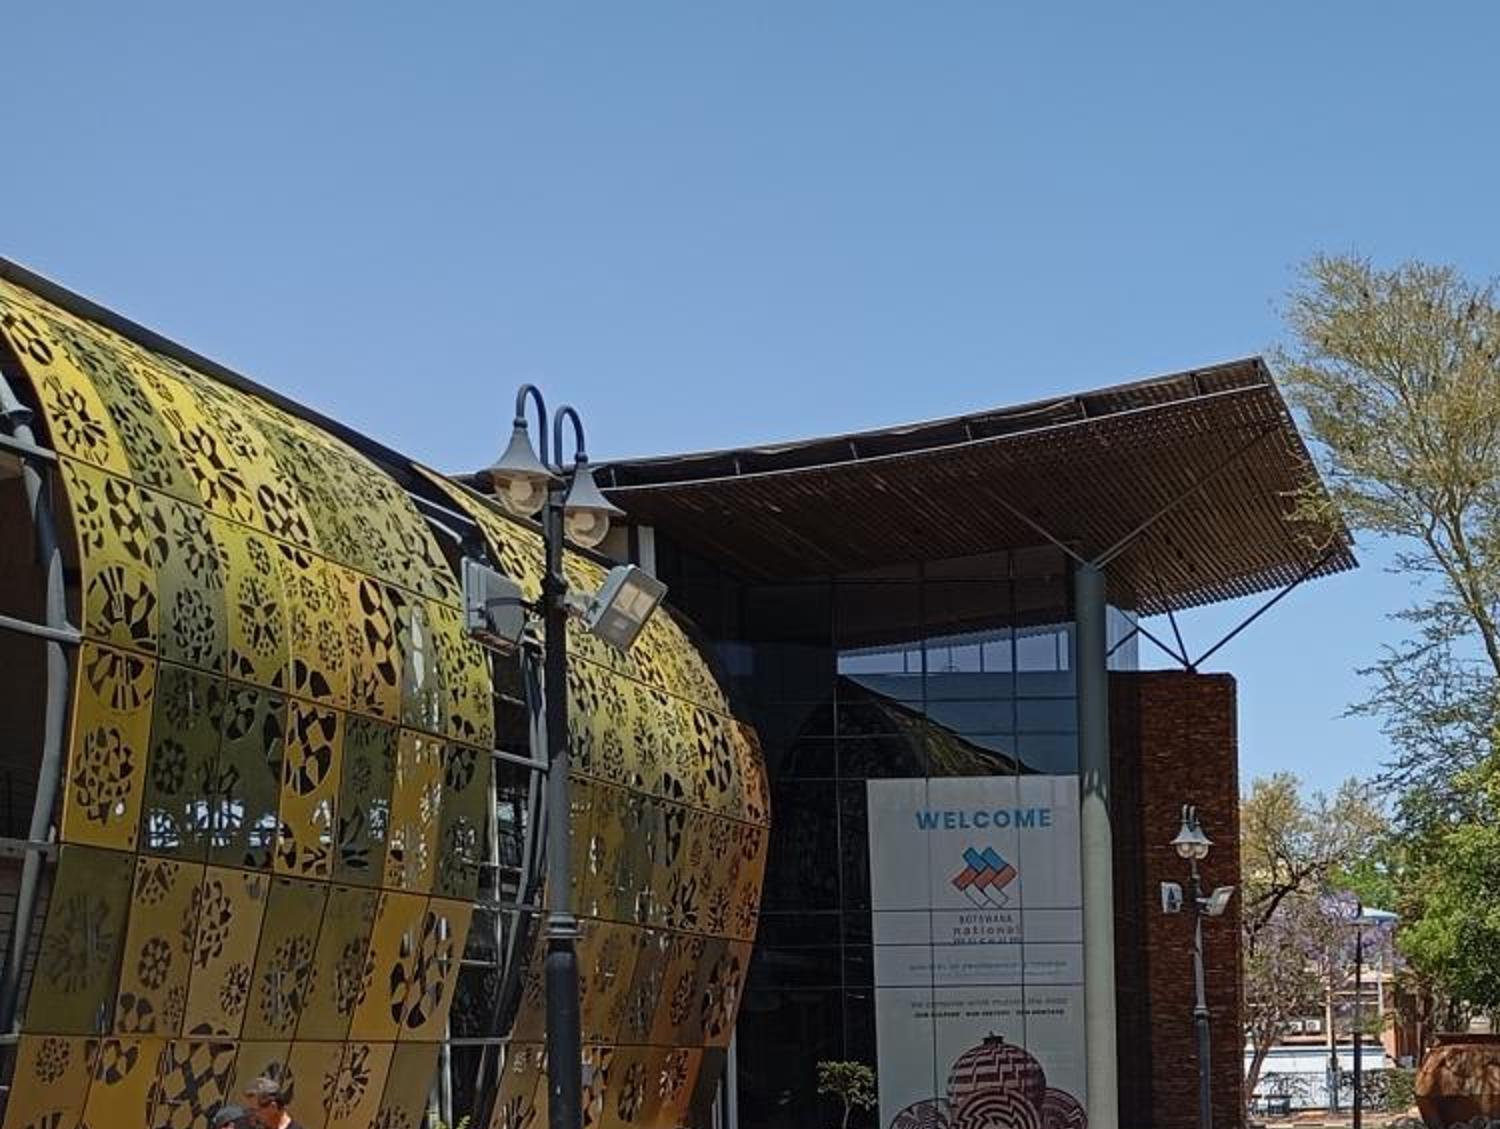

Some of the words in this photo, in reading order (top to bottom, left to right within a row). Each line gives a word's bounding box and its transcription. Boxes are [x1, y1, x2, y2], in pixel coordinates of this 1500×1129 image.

[916, 808, 1052, 830] WELCOME
[959, 914, 1013, 924] BOTSWANA
[953, 925, 1021, 935] national
